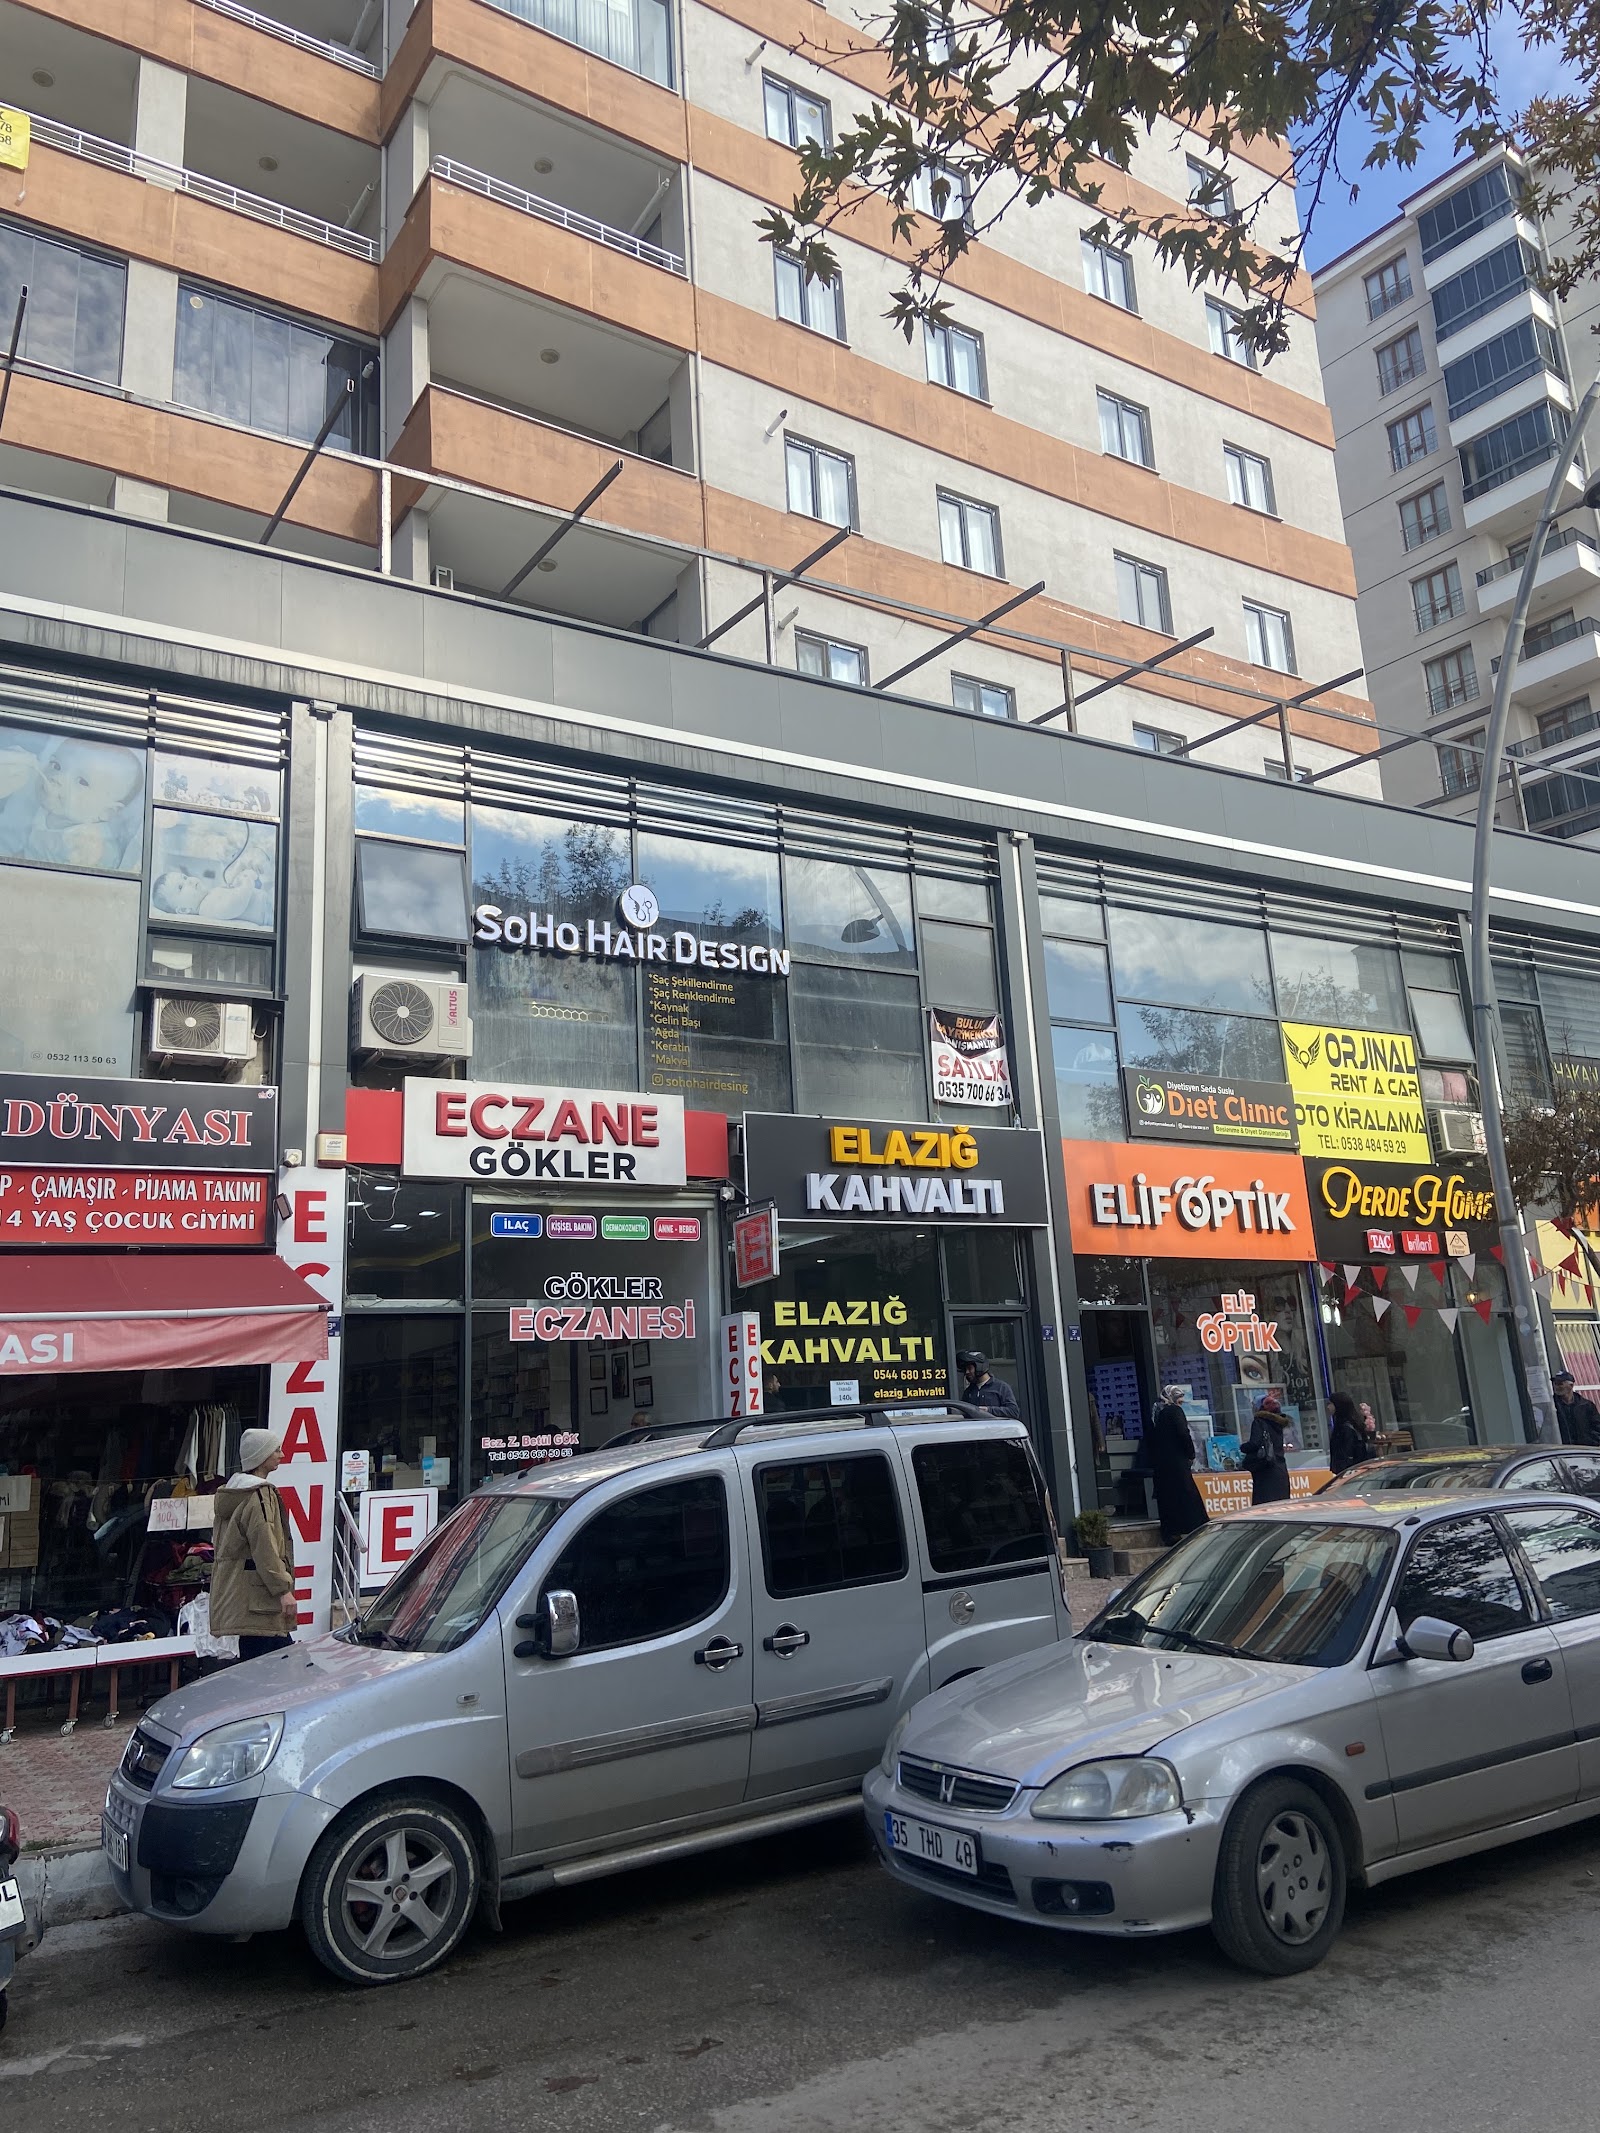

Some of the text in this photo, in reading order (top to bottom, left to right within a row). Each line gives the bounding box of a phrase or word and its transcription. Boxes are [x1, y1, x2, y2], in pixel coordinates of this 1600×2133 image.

[674, 931, 791, 975] DESIGN
[449, 991, 457, 1017] ALTUS
[672, 989, 736, 1005] Renklendirme
[654, 1014, 679, 1025] Gelin
[956, 1017, 985, 1030] BULUT
[47, 1053, 117, 1065] 0532 113 50 63
[666, 1077, 748, 1094] sohohairdesing
[939, 1081, 1011, 1101] 0535 700 66 34
[1167, 1081, 1200, 1093] Diyetisyen
[1201, 1084, 1217, 1094] Seda
[1330, 1073, 1419, 1097] RENT A CAR
[1, 1092, 253, 1146] DÜNYASI
[435, 1090, 660, 1147] ECZANE
[1166, 1090, 1290, 1126] Diet Clinic
[1294, 1101, 1426, 1134] OTO KİRALAMA
[830, 1125, 979, 1169] ELAZIĞ
[1318, 1135, 1406, 1154] TEL: 0538 484 59 29
[469, 1142, 637, 1181] GÖKLER
[31, 1175, 116, 1206] ÇAMAŞIR
[135, 1174, 198, 1201] PİJAMA
[203, 1180, 261, 1202] TAKIMI
[806, 1173, 1005, 1214] KAHVALTI
[1090, 1173, 1172, 1226] ELİF
[31, 1210, 77, 1233] YAŞ
[85, 1211, 175, 1234] ÇOCUK
[181, 1208, 255, 1230] GİYİMİ
[503, 1218, 529, 1233] İLAÇ
[551, 1219, 592, 1233] KİŞİSEL BAKIM
[658, 1224, 673, 1233] ANNE
[678, 1224, 696, 1234] BEBEK
[1371, 1235, 1391, 1251] TAÇ
[1408, 1234, 1433, 1251] brillant
[544, 1272, 663, 1299] GÖKLER
[774, 1295, 908, 1326] ELAZIĞ
[1221, 1289, 1256, 1315] ELİF
[509, 1299, 696, 1342] ECZANESİ
[0, 1333, 73, 1364] ASI
[759, 1336, 934, 1364] KAHVALTI
[873, 1369, 946, 1380] 0544 680 15 23
[874, 1386, 945, 1399] elazig_kahvalti
[481, 1432, 579, 1448] Ecz. Z. Betül GÖK
[489, 1452, 506, 1461] Tel:
[507, 1450, 529, 1460] 0542
[548, 1448, 560, 1458] 50
[1205, 1477, 1231, 1495] TÜM
[153, 1500, 185, 1511] 3 PARÇA
[157, 1512, 172, 1523] 100
[170, 1519, 181, 1528] TL
[382, 1506, 413, 1562] E
[893, 1818, 908, 1847] 35
[918, 1826, 942, 1859] THD
[955, 1838, 972, 1868] 48
